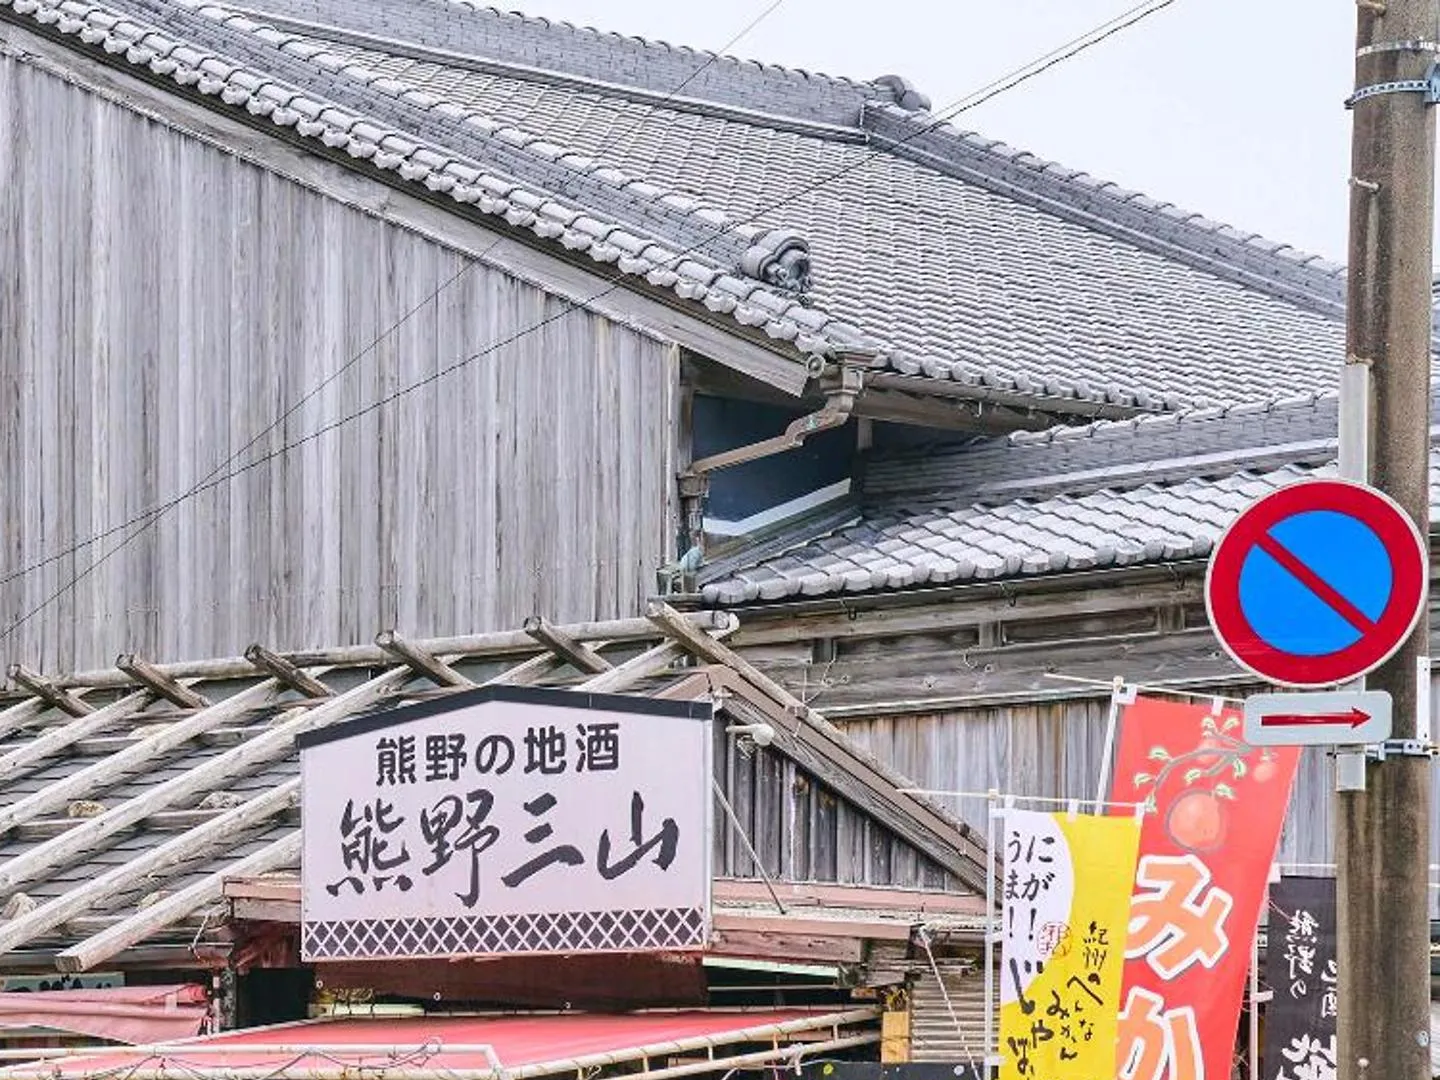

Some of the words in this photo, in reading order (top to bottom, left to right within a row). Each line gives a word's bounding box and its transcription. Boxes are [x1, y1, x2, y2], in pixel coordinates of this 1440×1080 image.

[376, 722, 620, 786] 熊野の地酒
[326, 788, 679, 909] 熊野三山
